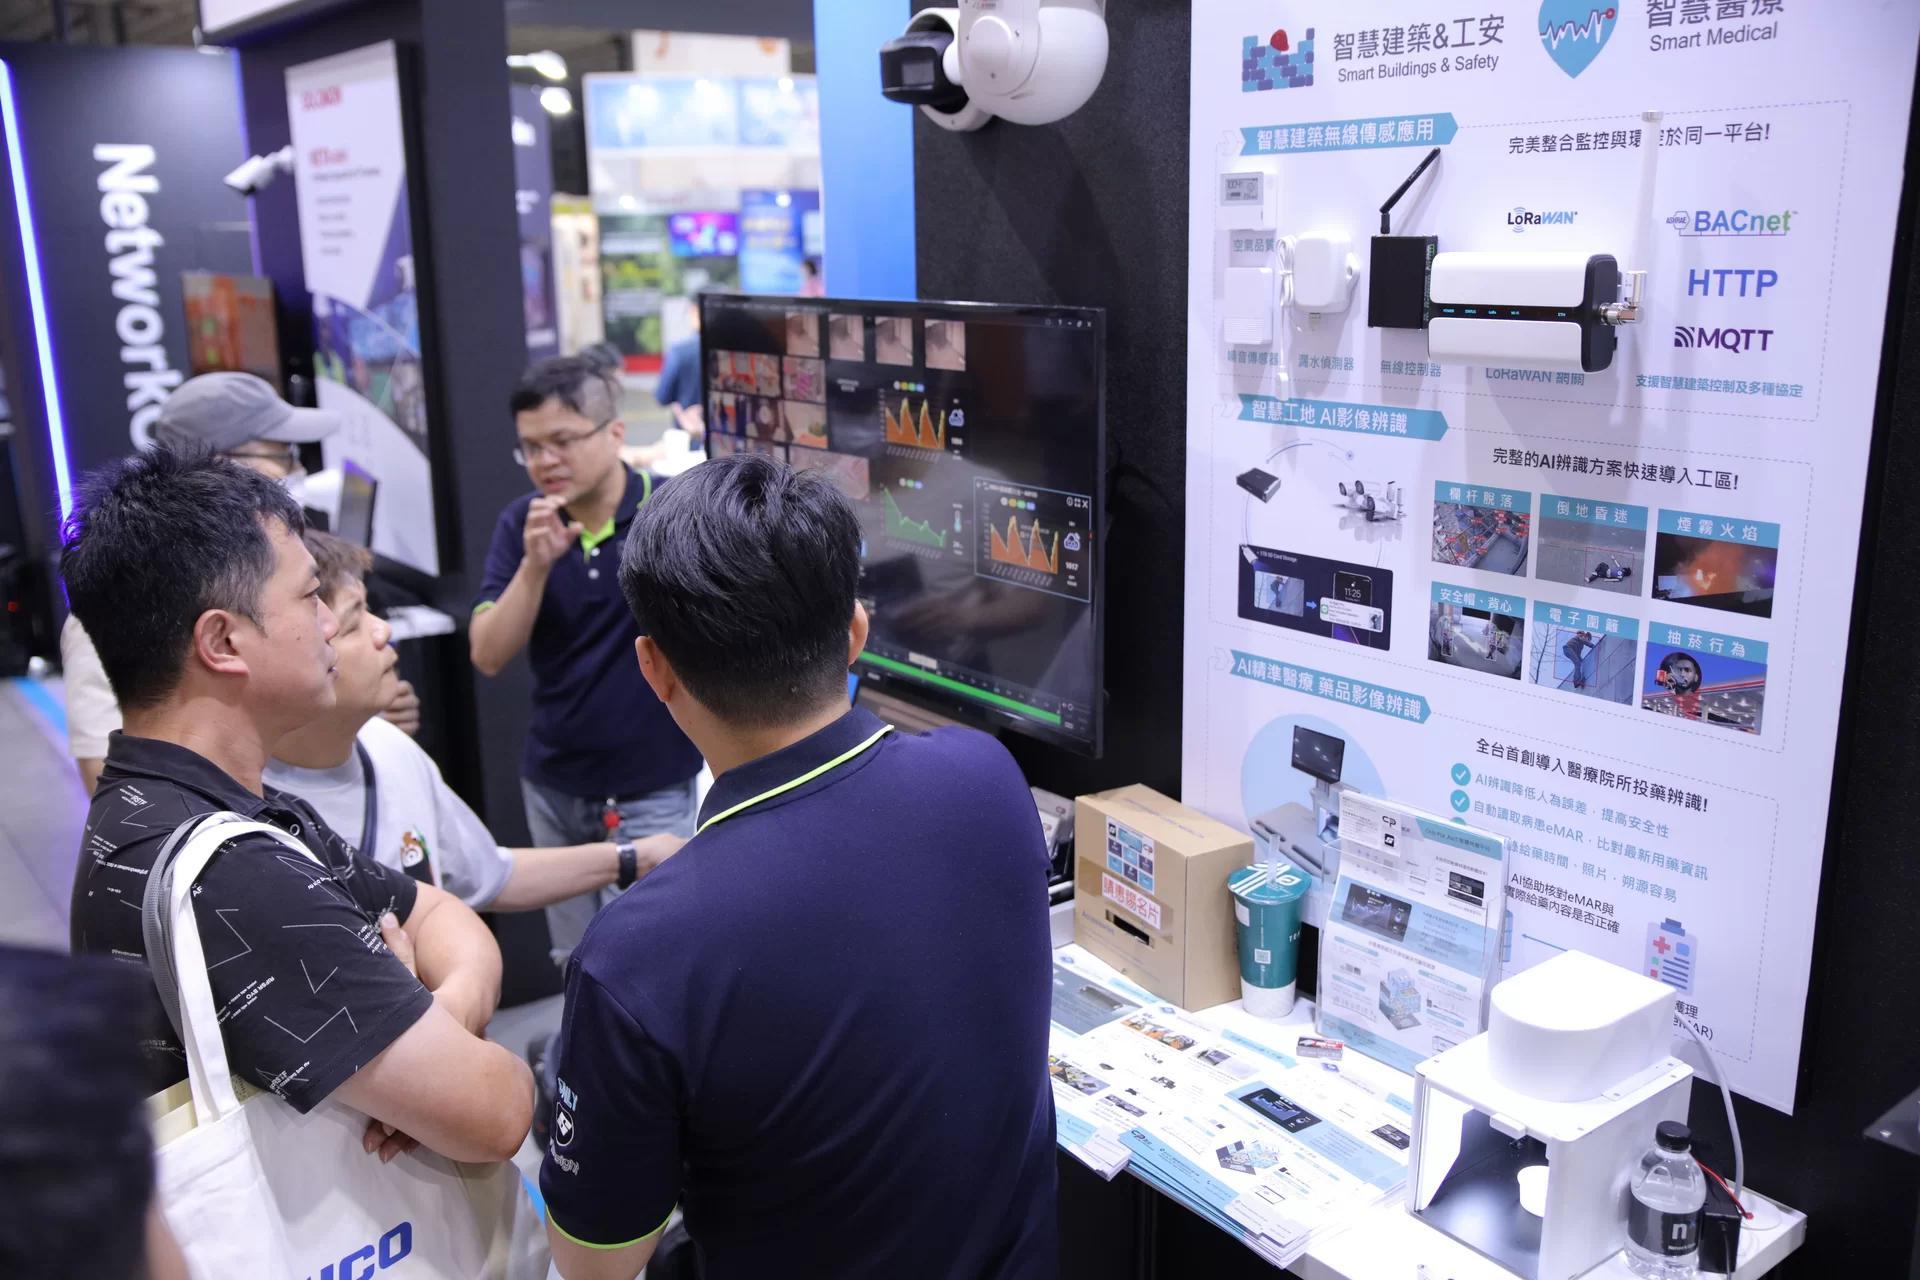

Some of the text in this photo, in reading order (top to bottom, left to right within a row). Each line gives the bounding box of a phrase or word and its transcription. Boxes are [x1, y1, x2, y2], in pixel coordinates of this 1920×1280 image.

[1333, 13, 1505, 62] 智慧建築&工安
[1649, 22, 1778, 52] Smart Medical
[1338, 54, 1500, 83] Smart Buildings & Safety
[1256, 117, 1434, 151] 智慧建築無線傳感應用
[1508, 122, 1771, 155] 完美整合監控與環於同一平台!
[1693, 208, 1792, 232] BACnet
[1687, 268, 1778, 298] HTTP
[1698, 327, 1774, 354] MQTT
[1380, 359, 1442, 378] 無線控制器
[1635, 373, 1804, 399] 支援智慧建築控制及多種協定
[1251, 399, 1408, 434] 智慧工地 AI影像辨識
[1492, 446, 1740, 491] 完整的AI辨識方案快速導入工區!
[1556, 500, 1629, 525] 倒地昏迷
[1676, 516, 1759, 542] 煙霧火焰
[1667, 629, 1747, 658] 抽菸行為
[1237, 656, 1422, 721] AI精準醫療 藥品影像辨識
[1475, 736, 1709, 814] 全台首創導入醫療院所投藥辨識!
[1510, 872, 1615, 918] AI協助核對eMAR與
